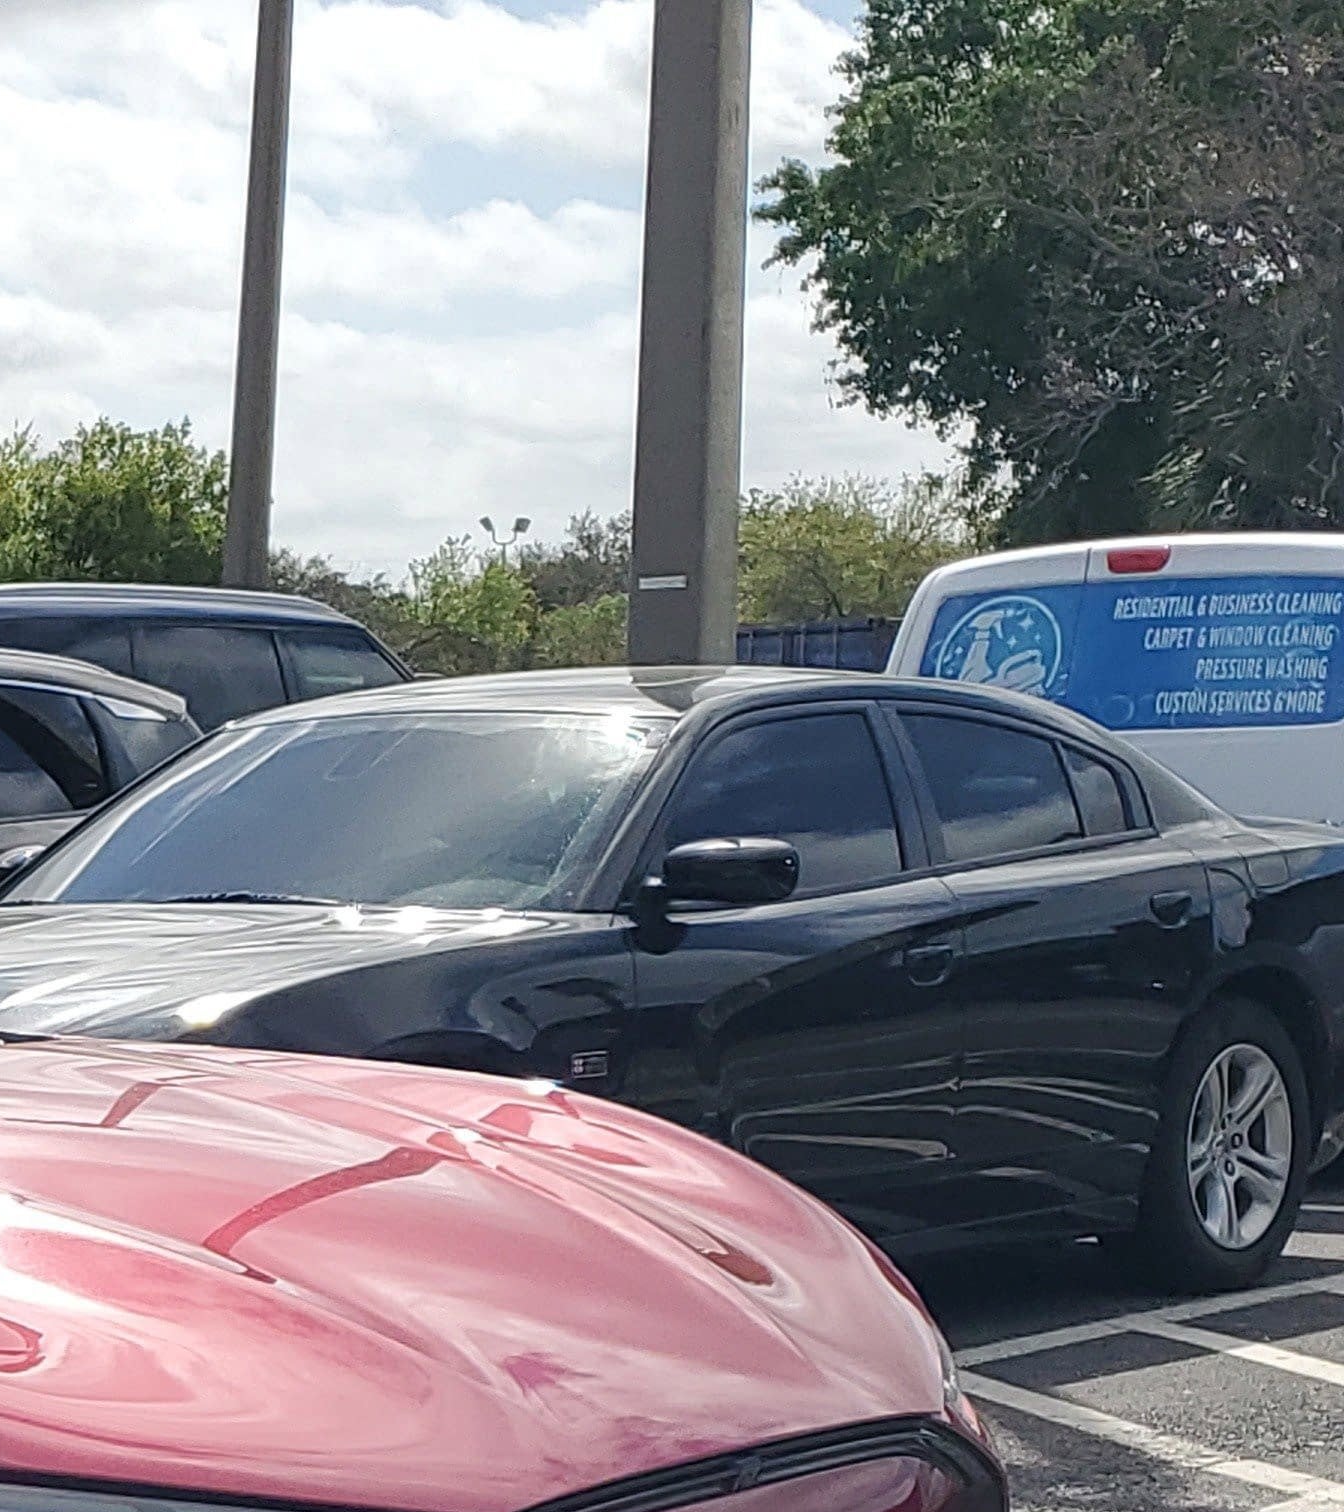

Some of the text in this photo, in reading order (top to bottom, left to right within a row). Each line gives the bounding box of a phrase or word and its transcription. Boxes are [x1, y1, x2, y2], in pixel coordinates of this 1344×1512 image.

[1114, 594, 1195, 620] RESIDENTIAL
[1209, 592, 1274, 616] BUSINESS
[1275, 592, 1343, 615] CLEANING
[1144, 627, 1194, 650] CARPET
[1209, 625, 1265, 648] WINDOW
[1267, 623, 1334, 648] CLEANING
[1195, 655, 1329, 680] PRESSURE WASHING
[1209, 689, 1272, 715] SERVICES
[1285, 689, 1326, 714] MORE
